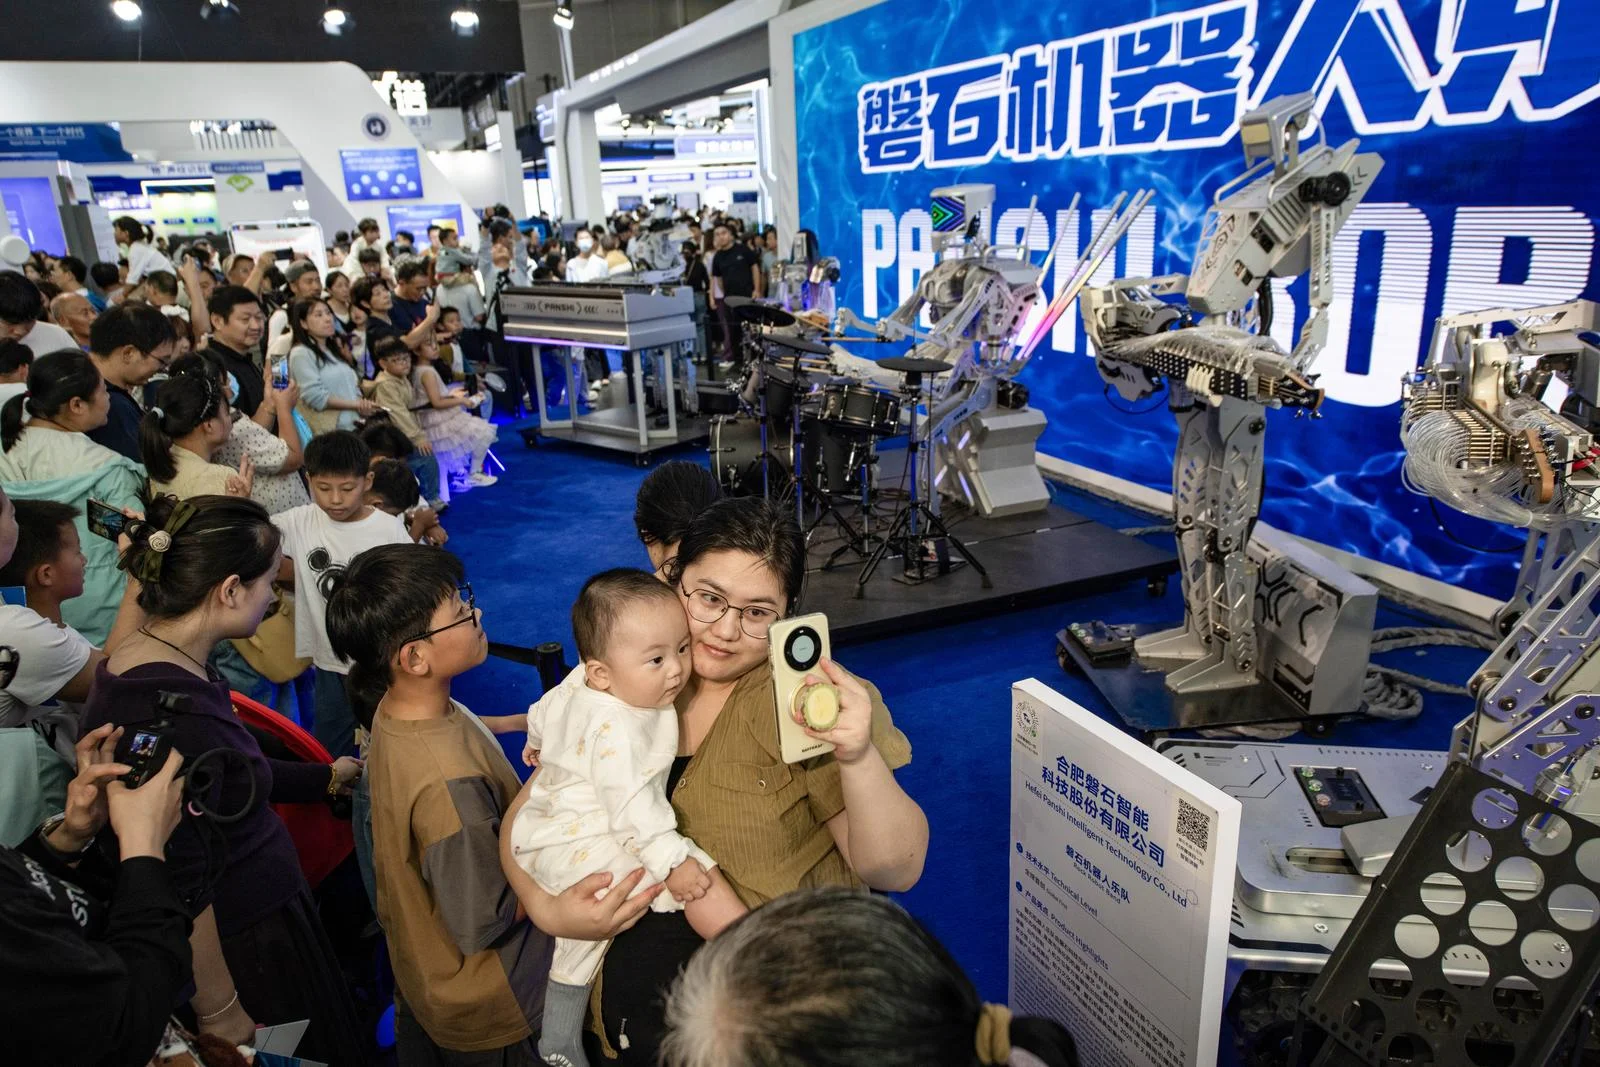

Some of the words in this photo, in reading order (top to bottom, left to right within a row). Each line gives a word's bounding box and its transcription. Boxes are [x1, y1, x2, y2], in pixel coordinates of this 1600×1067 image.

[544, 302, 576, 313] PANSHI
[861, 205, 1157, 358] PASH
[1041, 766, 1165, 868] 科技股份有限公司
[1056, 755, 1149, 832] 合肥磐石智能
[1025, 780, 1042, 800] Hefei
[1043, 794, 1066, 817] Panshi
[1066, 811, 1104, 846] Intelligent
[1105, 839, 1152, 883] Technology
[1153, 877, 1171, 898] Co.,
[1172, 889, 1188, 908] Ltd
[1065, 844, 1131, 904] 磐石机器人乐队
[1025, 850, 1050, 876] 技术水平
[1051, 871, 1080, 901] Technical
[1080, 896, 1098, 917] Level
[1073, 862, 1086, 877] Rock
[1088, 873, 1105, 892] Robot
[1106, 887, 1121, 905] Band
[1024, 890, 1049, 916] 产品亮点
[1051, 913, 1075, 939] Product
[1075, 934, 1109, 971] Highlights
